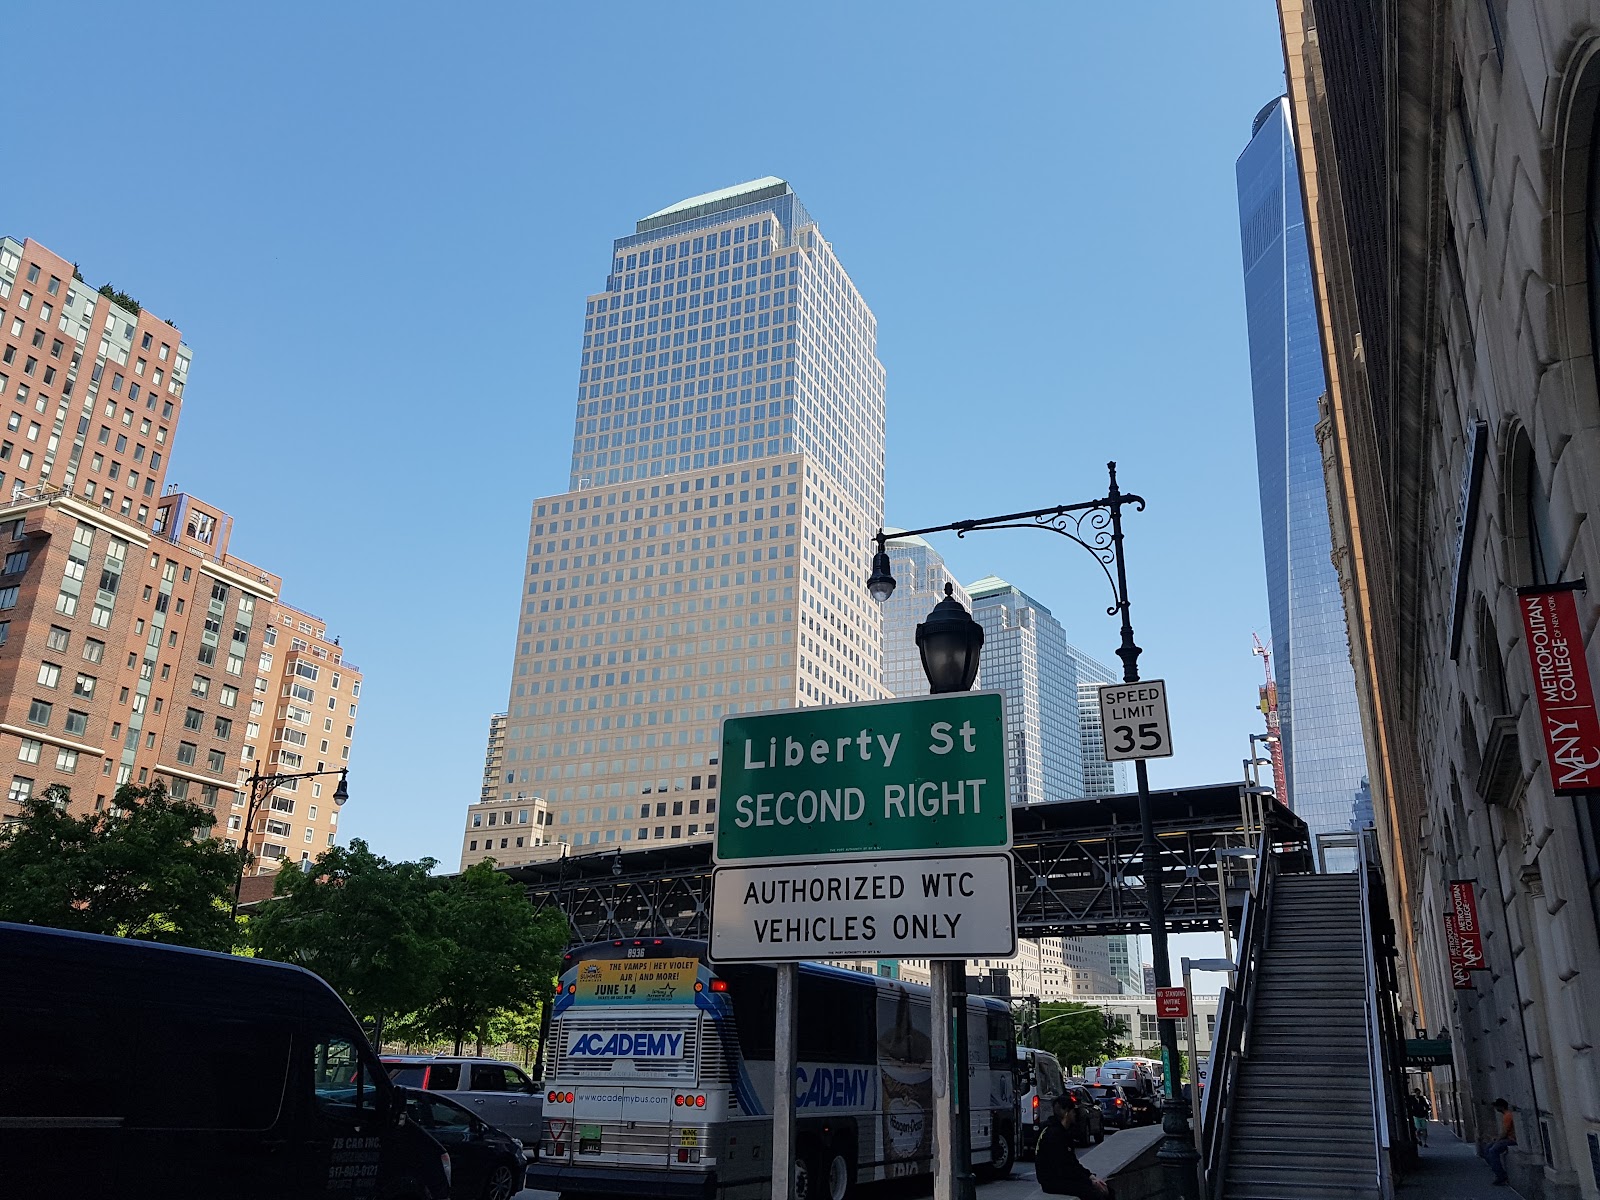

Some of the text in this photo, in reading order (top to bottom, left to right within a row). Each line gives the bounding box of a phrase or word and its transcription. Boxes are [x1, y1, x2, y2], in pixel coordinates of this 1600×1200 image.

[1526, 596, 1560, 702] METROPOLITAN
[1547, 595, 1578, 702] COLLEGE OF NEW YORK
[1106, 688, 1159, 704] SPEED
[1112, 704, 1155, 720] LIMIT
[744, 719, 977, 770] Liberty St
[1113, 722, 1162, 753] 35
[734, 778, 987, 828] SECOND RIGHT
[743, 872, 974, 905] AUTHORIZED WTC
[1453, 884, 1466, 931] METROPOLITAN
[1463, 903, 1474, 931] COLLEGE
[754, 913, 962, 944] VEHICLES ONLY
[627, 948, 645, 958] 8936
[595, 984, 636, 995] JUNE 14
[568, 1034, 683, 1056] ACADEMY
[578, 1094, 668, 1104] www.academybus.com
[795, 1067, 868, 1108] CADEMY
